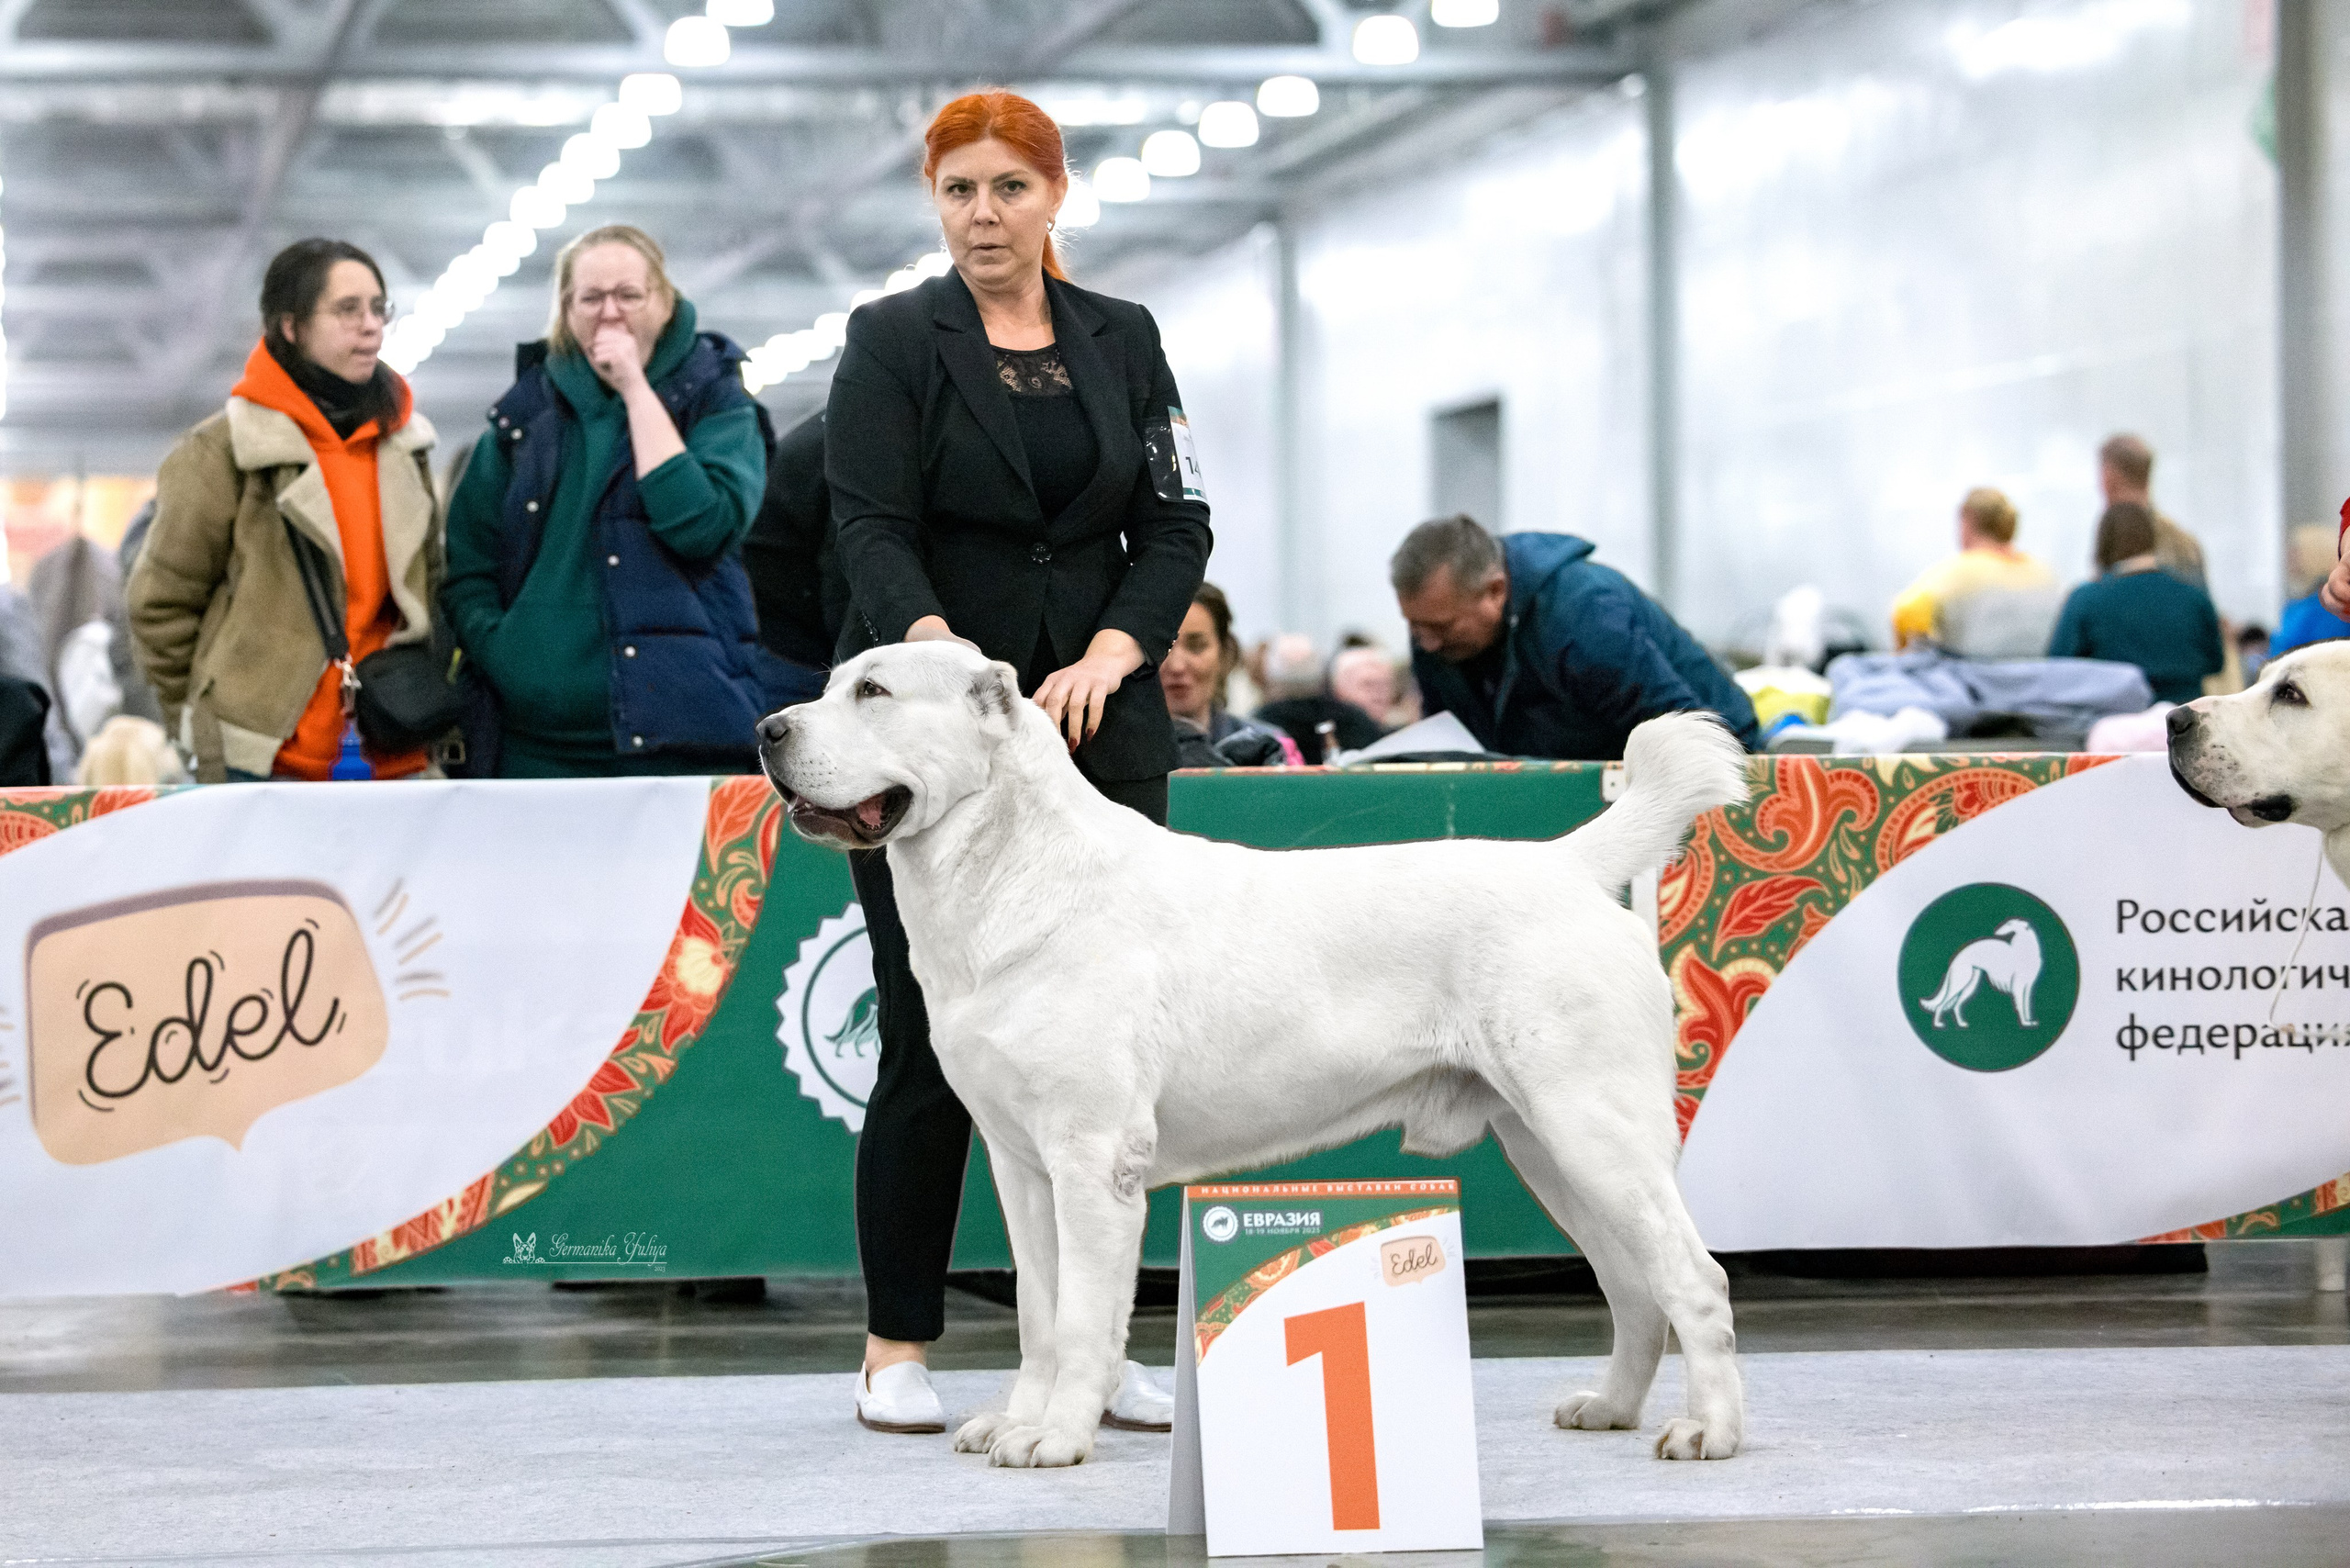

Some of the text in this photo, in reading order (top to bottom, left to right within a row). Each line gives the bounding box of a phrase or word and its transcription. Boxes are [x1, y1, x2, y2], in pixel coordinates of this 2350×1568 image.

[2116, 898, 2350, 934] Российска
[2116, 965, 2350, 991] кинологич
[84, 927, 341, 1099] Edel
[1201, 1182, 1455, 1194] НАЦИОНАЛЬНЫЕ ВЫСТАВКИ СОБАК
[1242, 1212, 1321, 1227] ЕВРАЗИЯ
[1391, 1243, 1438, 1276] Edel
[1282, 1300, 1382, 1531] 1
